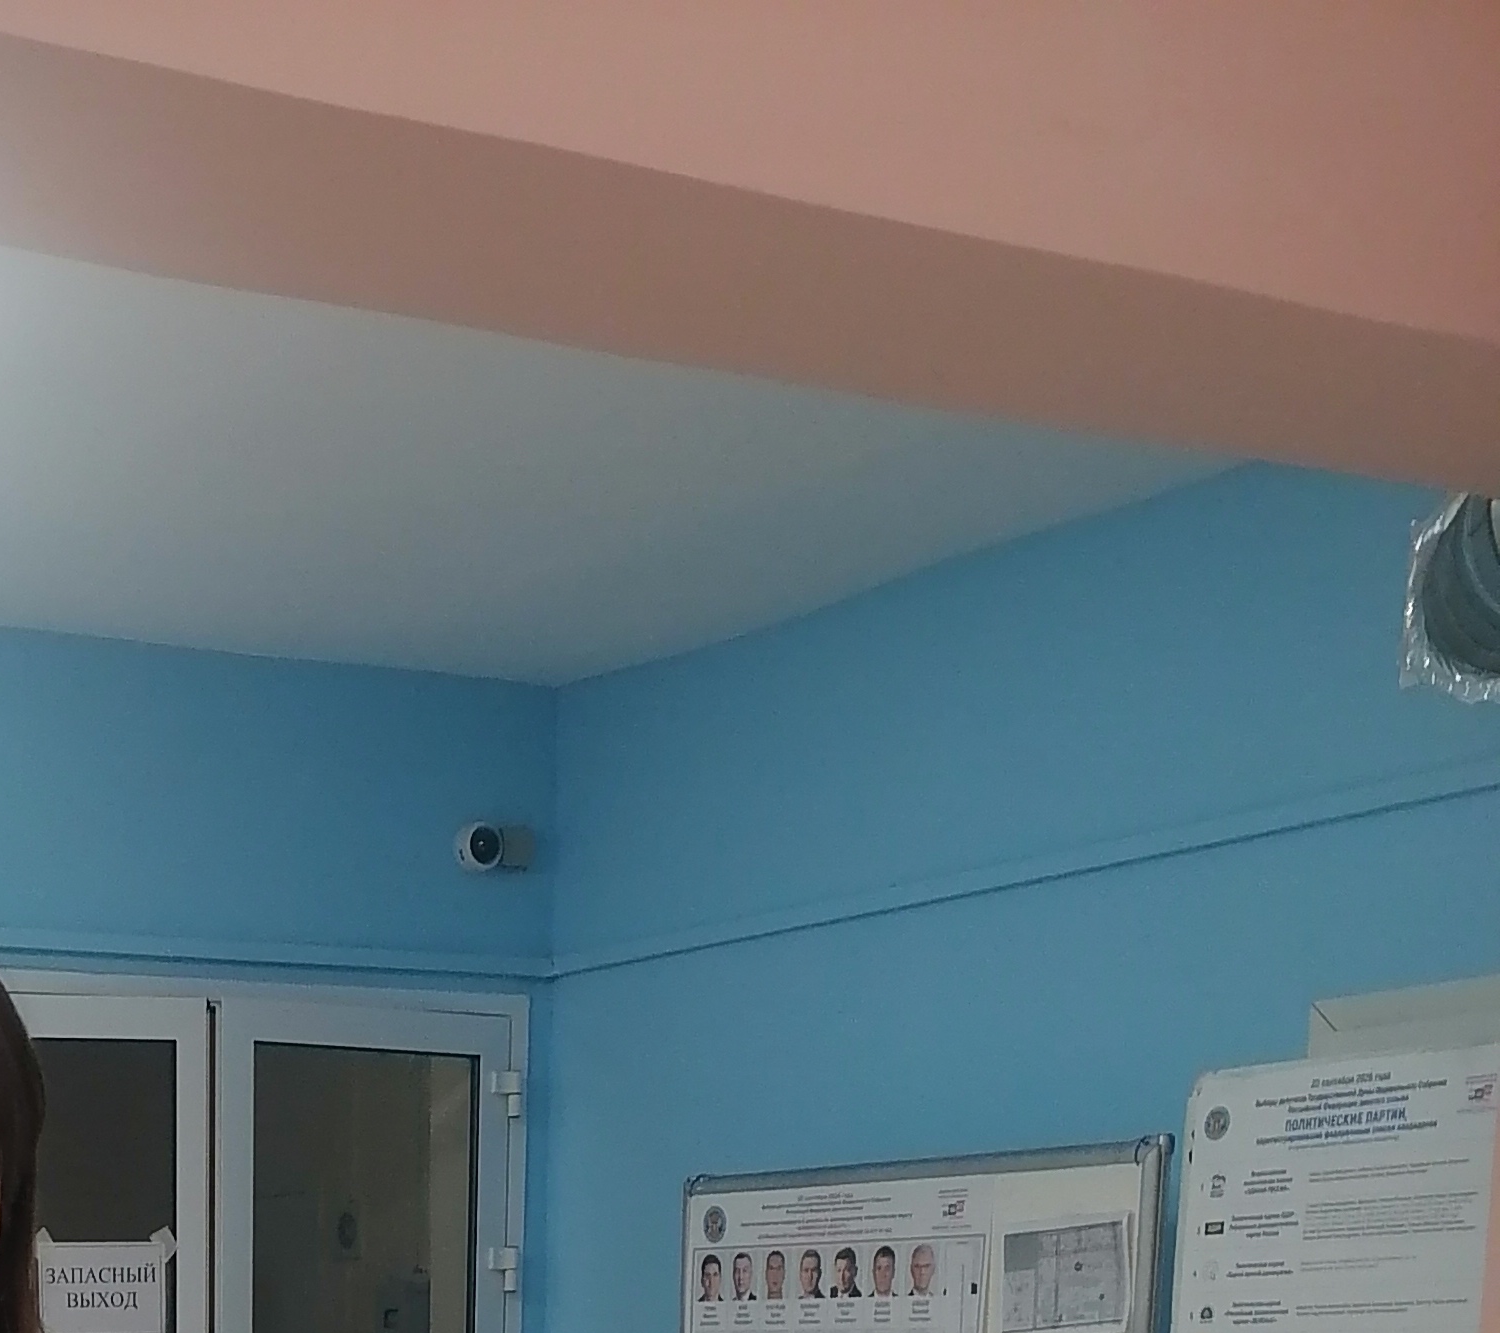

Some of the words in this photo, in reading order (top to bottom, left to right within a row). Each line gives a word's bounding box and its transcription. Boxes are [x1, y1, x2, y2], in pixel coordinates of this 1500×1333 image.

[1284, 1112, 1364, 1132] ПОЛИТИЧЕСКИЕ
[46, 1262, 157, 1285] ЗАПАСНЫЙ
[66, 1291, 139, 1311] ВЫХОД
